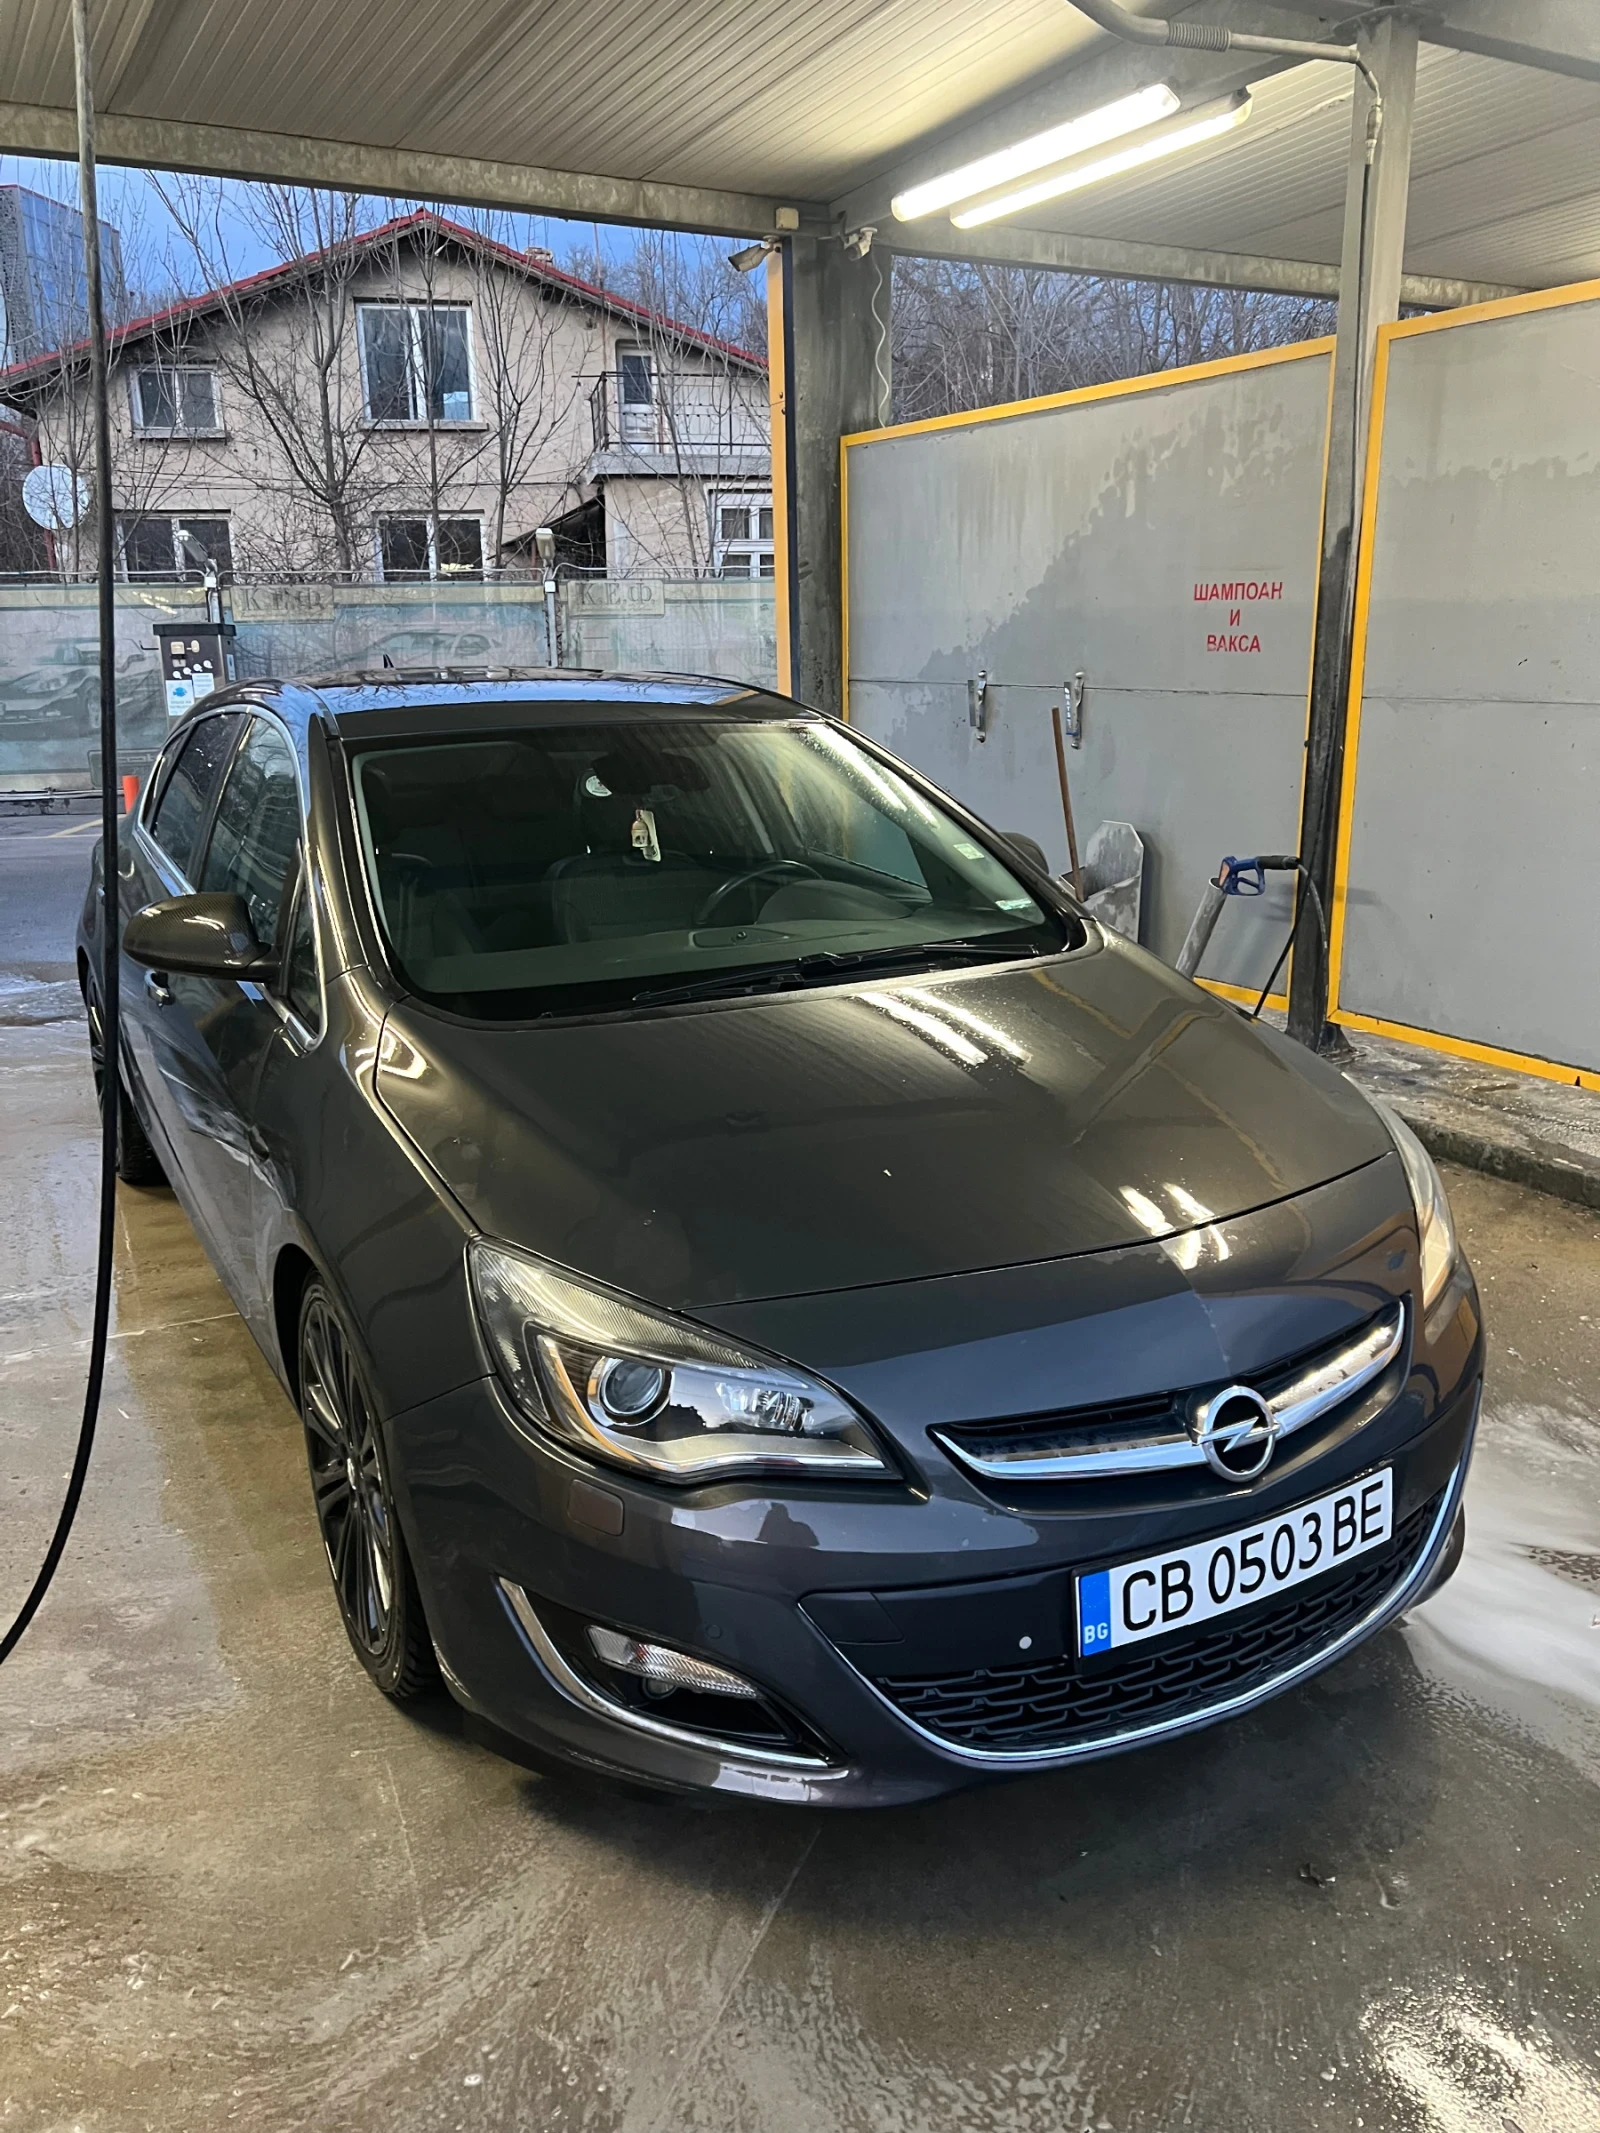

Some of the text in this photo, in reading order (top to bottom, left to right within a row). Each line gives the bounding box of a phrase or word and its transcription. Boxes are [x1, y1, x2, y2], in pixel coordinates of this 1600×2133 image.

[1194, 582, 1283, 601] ШАМПОАН
[1229, 608, 1241, 627] И
[1206, 634, 1261, 653] ВАКСА
[1122, 1479, 1385, 1631] CB 0503 BE
[1084, 1622, 1109, 1645] BG
